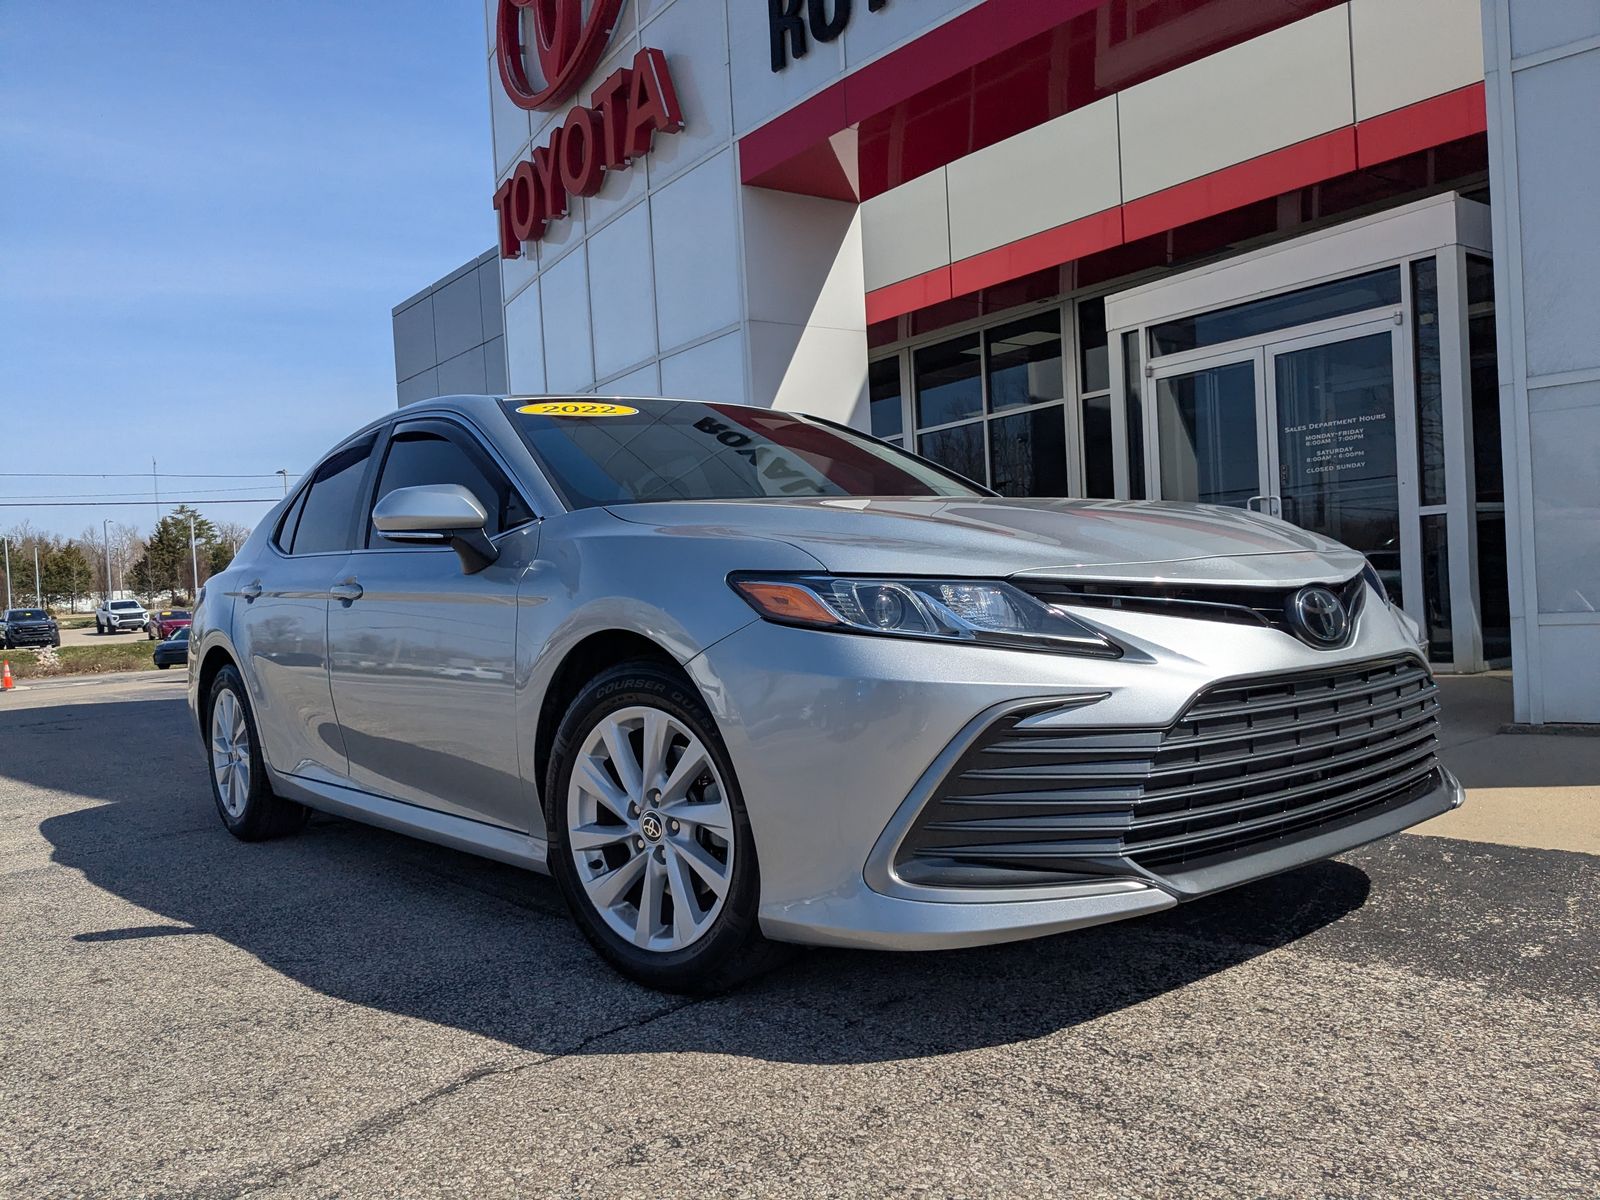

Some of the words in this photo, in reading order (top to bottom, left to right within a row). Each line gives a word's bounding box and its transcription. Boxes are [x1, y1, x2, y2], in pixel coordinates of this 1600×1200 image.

[493, 47, 685, 259] TOYOTA
[542, 404, 617, 415] 2022
[1305, 429, 1364, 440] MONDAY-FRIDAY
[1338, 434, 1364, 442] 7:00PM
[1316, 447, 1353, 456] SATURDAY
[1306, 465, 1334, 474] CLOSED
[1336, 462, 1366, 471] SUNDAY
[596, 679, 667, 700] COURSER
